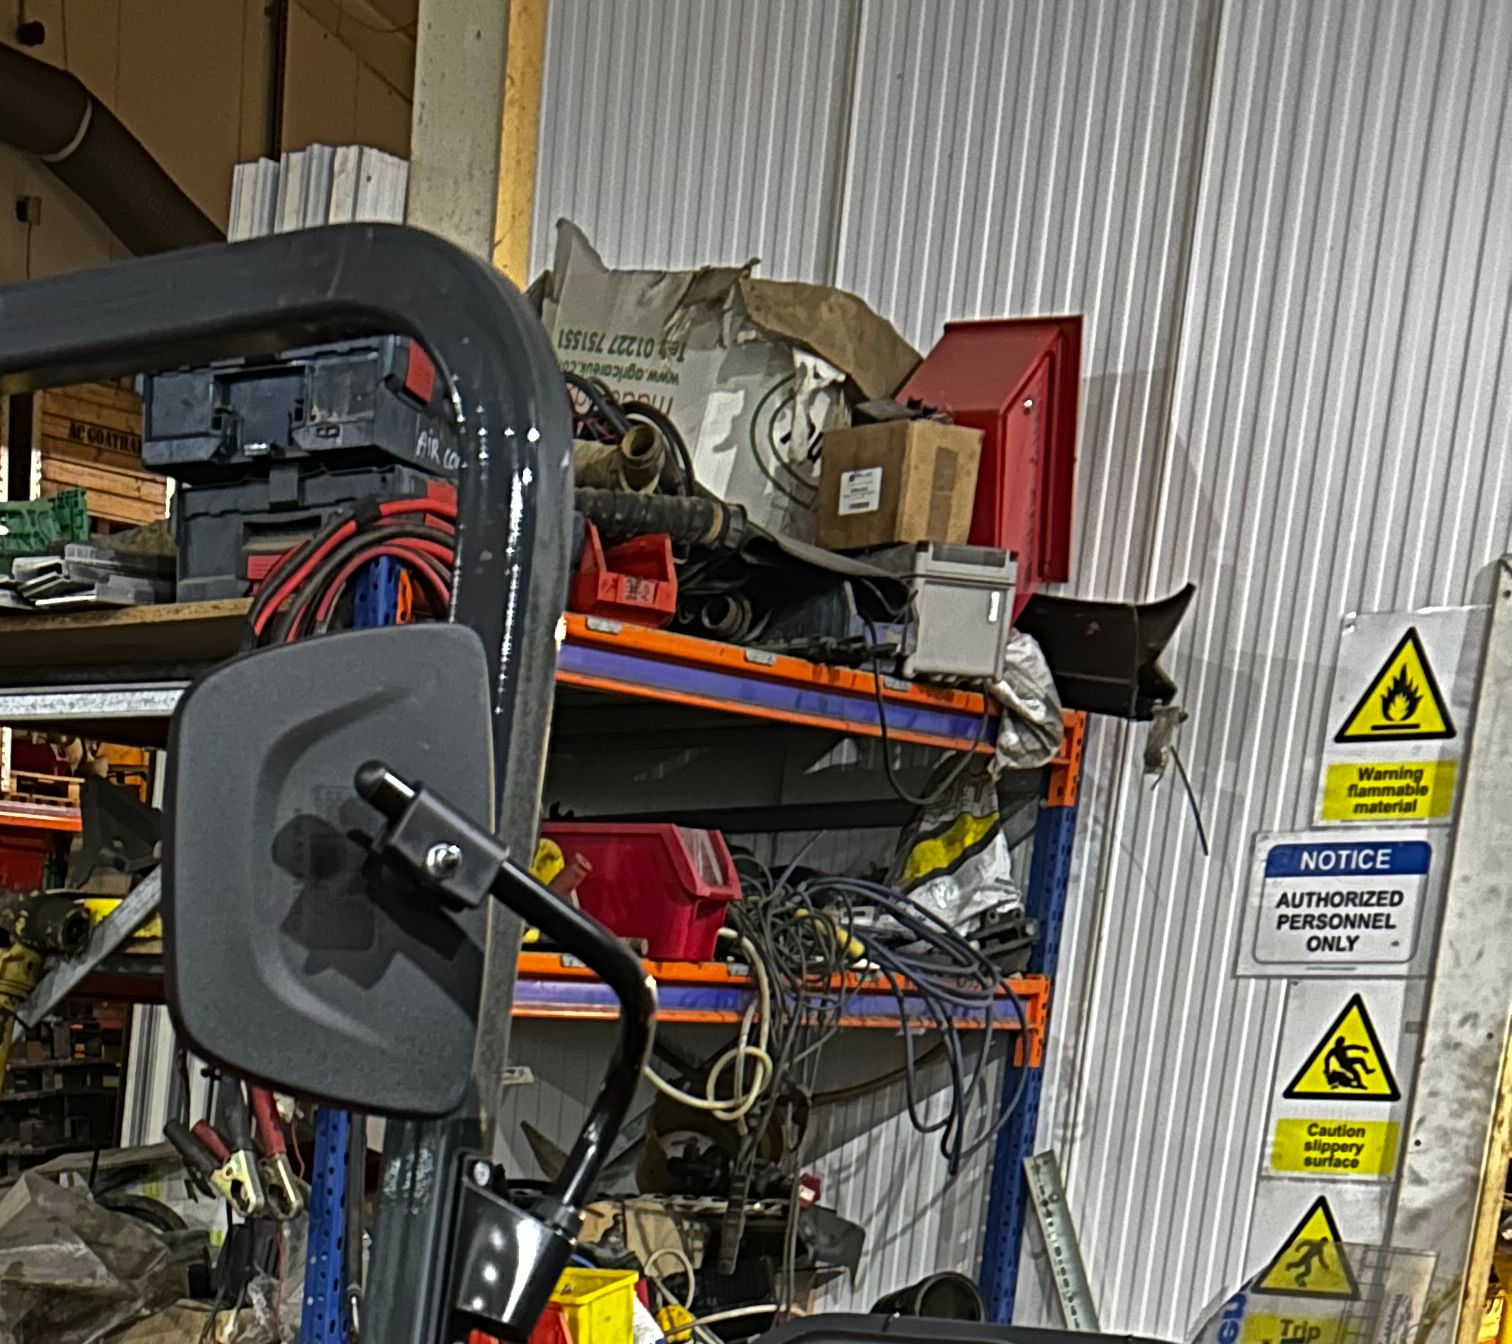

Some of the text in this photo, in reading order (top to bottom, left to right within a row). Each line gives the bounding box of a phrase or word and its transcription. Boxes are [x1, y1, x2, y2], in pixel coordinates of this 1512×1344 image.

[558, 328, 606, 351] 751551
[607, 333, 655, 358] 01227
[559, 359, 679, 385] www.agricareuk.co
[1358, 766, 1424, 782] Warning
[1347, 783, 1429, 798] flammable
[1353, 799, 1418, 814] material
[1299, 848, 1392, 871] NOTICE
[1275, 890, 1404, 910] AUTHORIZED
[1276, 913, 1397, 931] PERSONNEL
[1306, 935, 1360, 952] ONLY
[1306, 1122, 1366, 1138] Caution
[1303, 1140, 1365, 1156] slippery
[1303, 1156, 1360, 1169] surface
[1279, 1318, 1321, 1342] Trip
